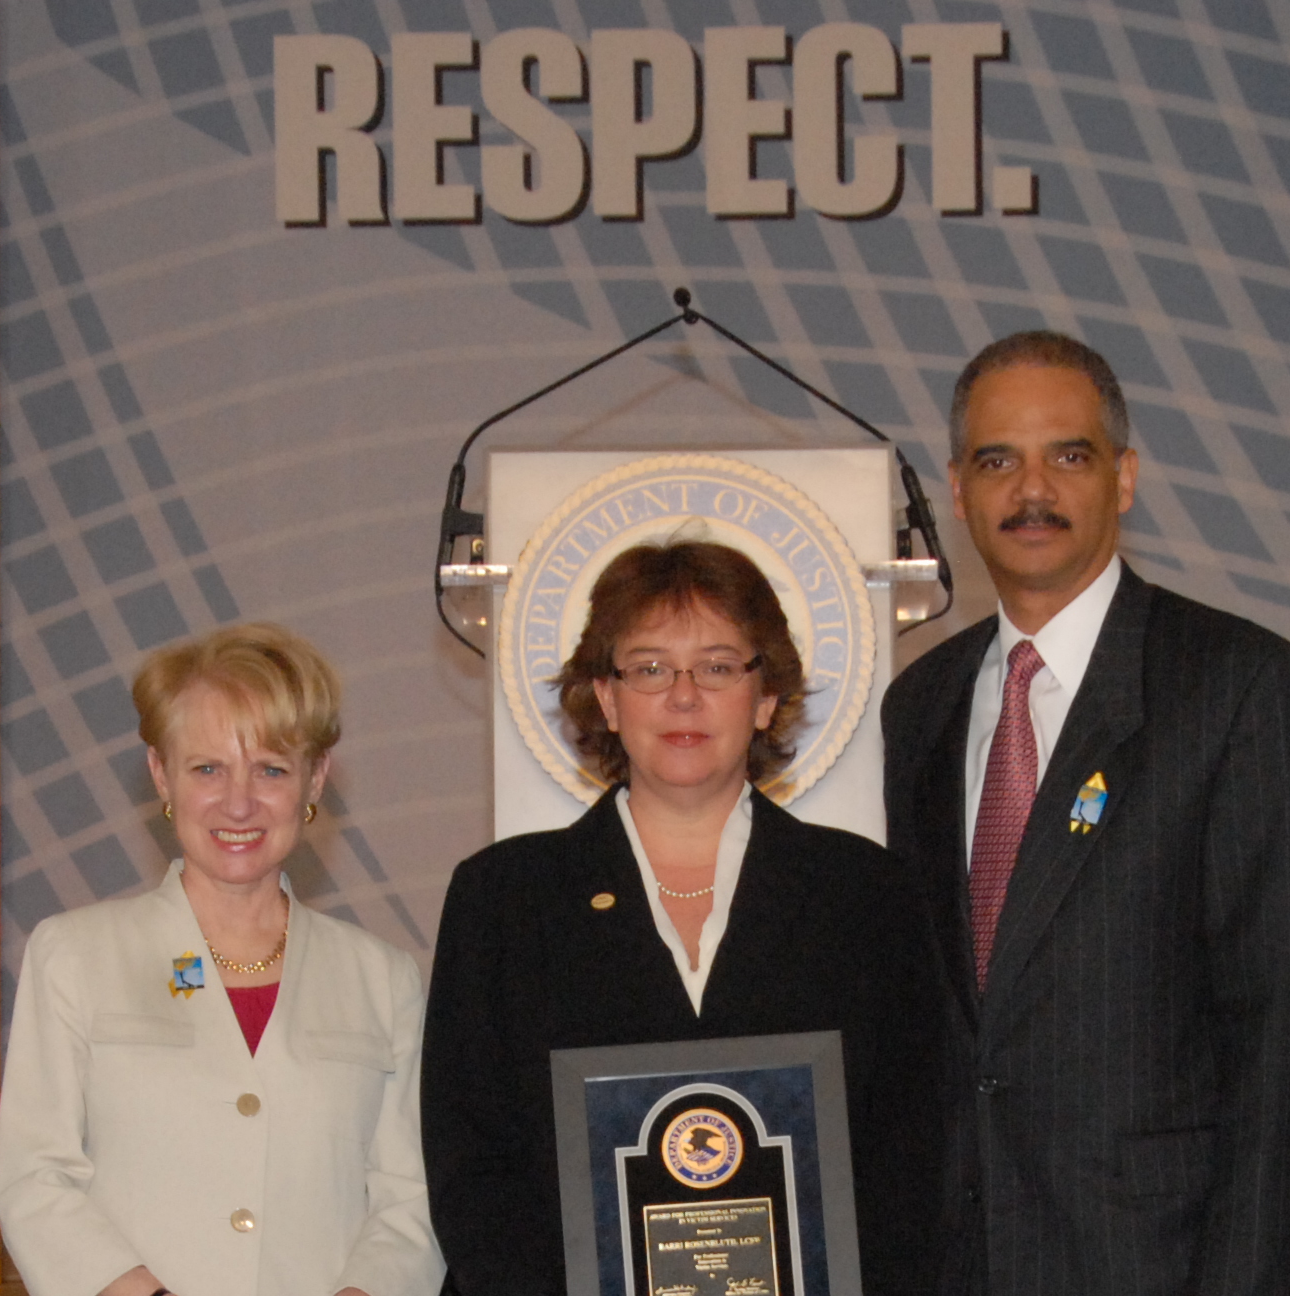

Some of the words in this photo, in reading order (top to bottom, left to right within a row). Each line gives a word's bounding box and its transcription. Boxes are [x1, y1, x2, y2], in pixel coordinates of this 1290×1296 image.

[274, 22, 1040, 229] RESPECT.
[526, 482, 699, 685] DEPARTMENT
[712, 488, 769, 526] OF
[770, 524, 846, 691] JUSTICE
